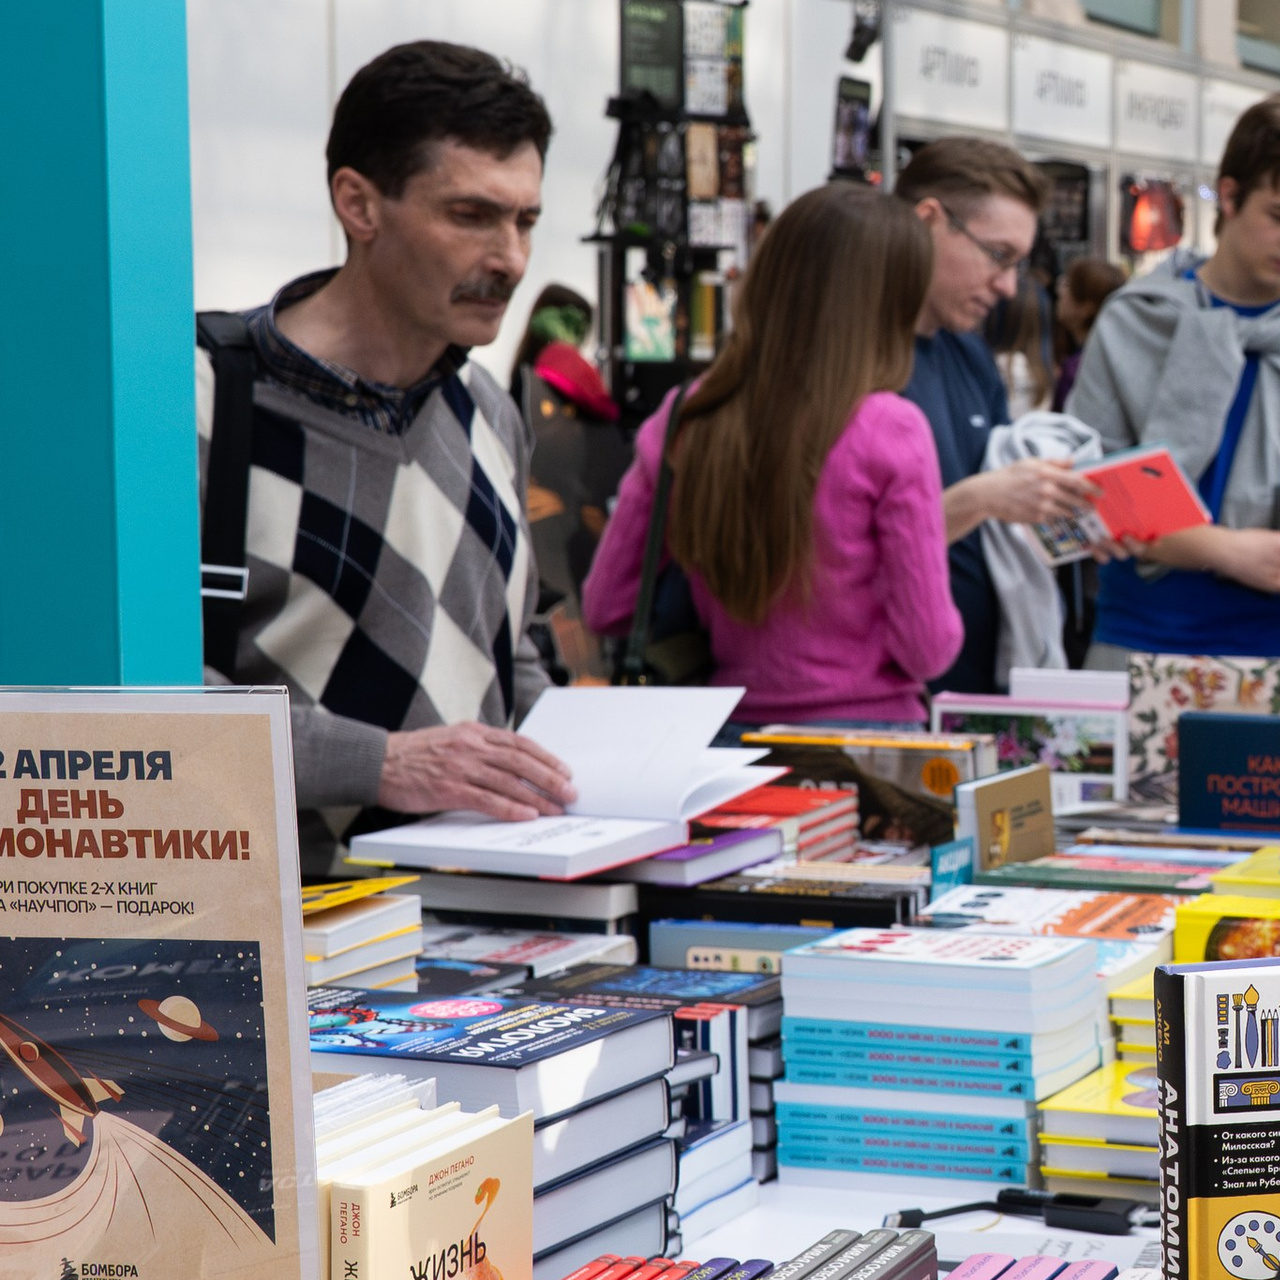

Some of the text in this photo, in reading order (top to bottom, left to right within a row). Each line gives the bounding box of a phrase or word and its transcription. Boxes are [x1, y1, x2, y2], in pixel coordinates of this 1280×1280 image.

[13, 750, 172, 780] АПРЕЛЯ
[17, 789, 124, 824] ДЕНЬ
[17, 881, 87, 895] ПОКУПКЕ
[118, 883, 157, 895] КНИГ
[10, 900, 195, 916] «НАУЧПОП» ПОДАРОК!
[450, 1007, 607, 1060] БИОЛОГИЯ
[1163, 1020, 1170, 1045] ЛИ
[1221, 1132, 1233, 1141] От
[1235, 1130, 1266, 1141] какого
[1221, 1140, 1275, 1151] Милосская?
[1221, 1155, 1248, 1164] Из-за
[1250, 1153, 1280, 1164] какого
[429, 1155, 475, 1185] ДЖОН ПЕГАНО
[1222, 1165, 1265, 1175] «Слепые»
[1222, 1180, 1242, 1189] Знал
[1243, 1180, 1257, 1188] ли
[340, 1202, 348, 1244] ПЕГАНО
[351, 1202, 361, 1237] ДЖОН
[81, 1263, 138, 1279] БОМБОРА
